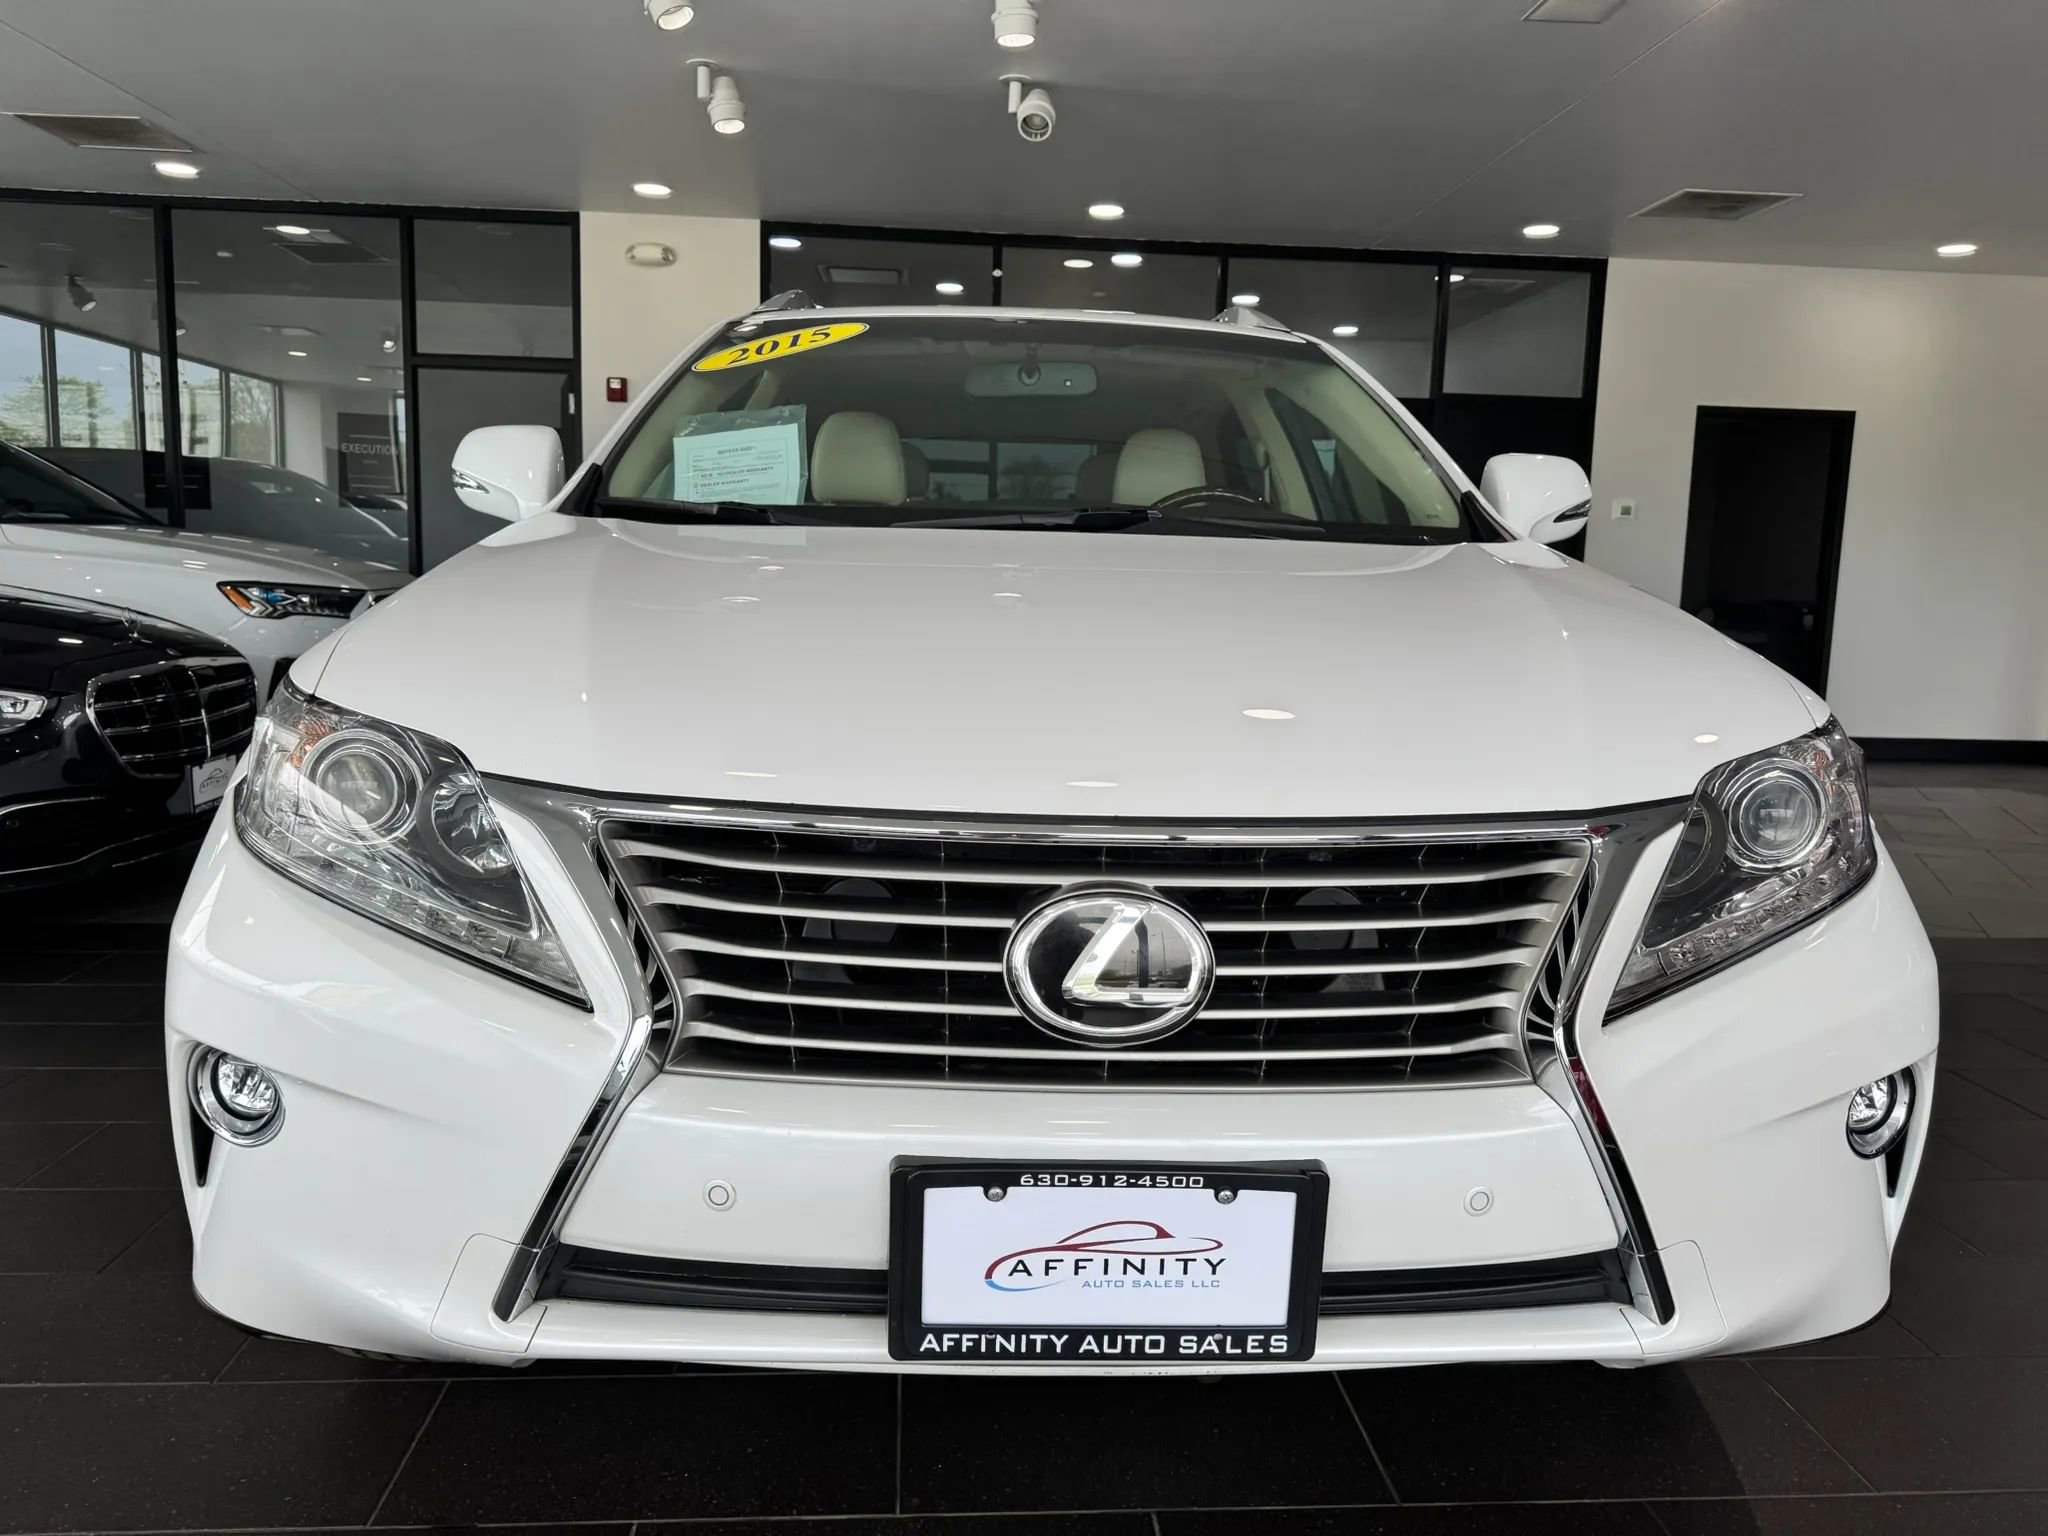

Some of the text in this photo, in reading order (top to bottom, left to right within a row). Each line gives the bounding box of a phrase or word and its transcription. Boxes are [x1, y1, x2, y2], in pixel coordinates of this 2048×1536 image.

[726, 327, 831, 365] 2015
[1020, 1174, 1204, 1188] 630-912-4500
[1008, 1258, 1226, 1276] AFFINITY
[1082, 1280, 1221, 1289] AUTO SALES LLC
[919, 1333, 1288, 1354] AFFINITY AUTO SALES
